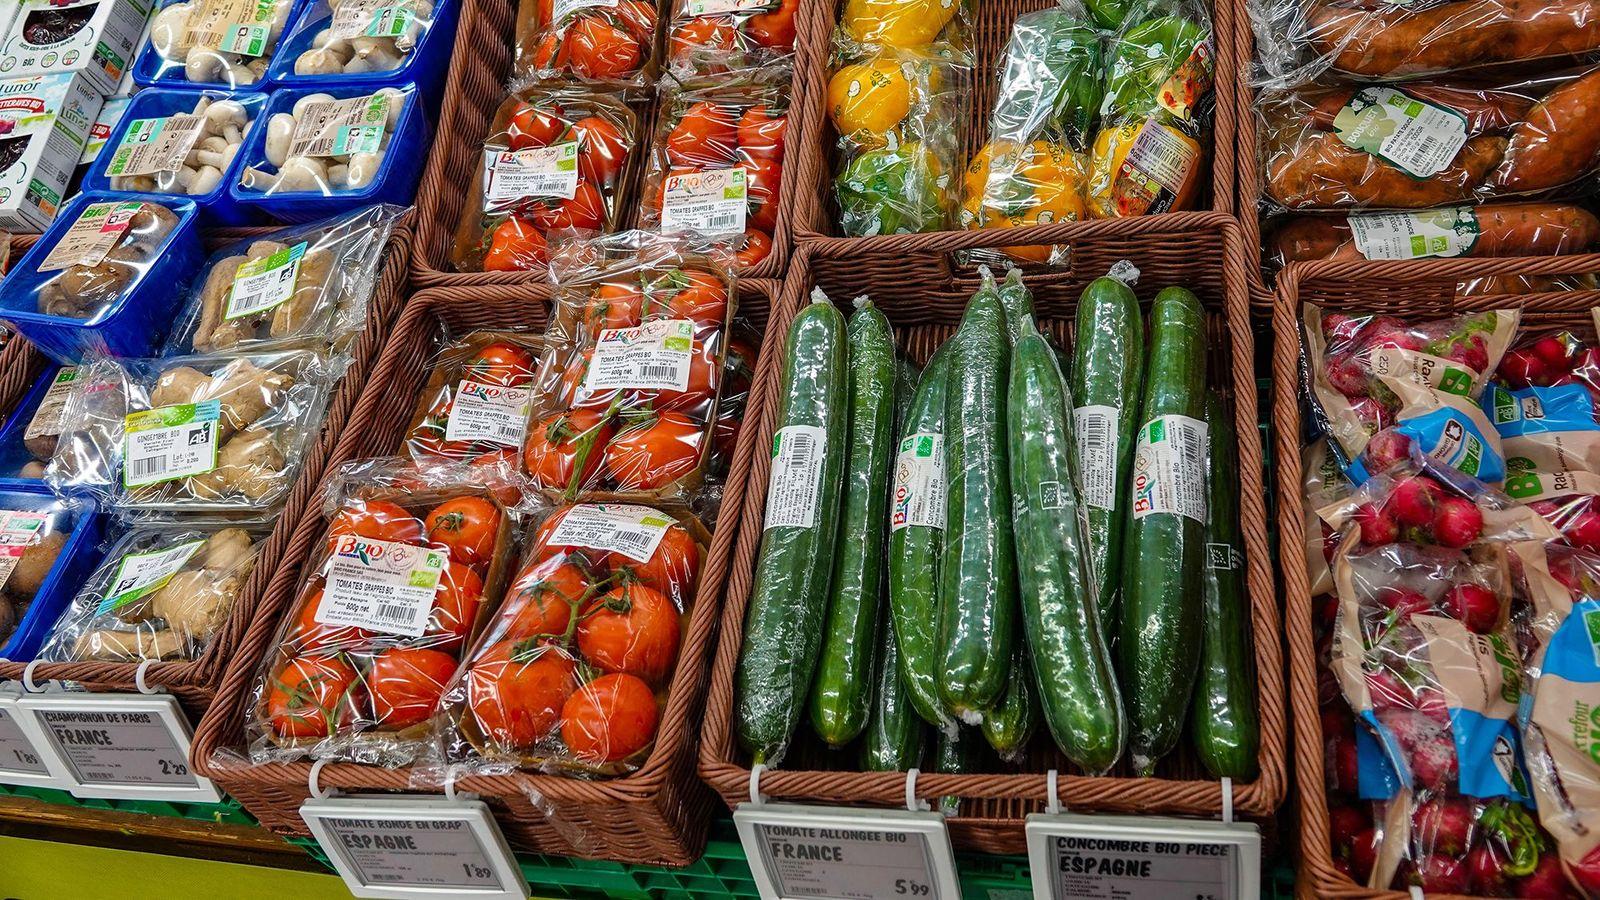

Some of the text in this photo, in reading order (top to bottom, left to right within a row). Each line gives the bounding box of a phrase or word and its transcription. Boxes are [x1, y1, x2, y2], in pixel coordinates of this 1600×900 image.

[22, 58, 35, 67] BIO
[76, 83, 95, 101] Lunor
[60, 107, 89, 130] Lunor
[1347, 108, 1378, 145] BOUQUET
[1384, 116, 1414, 153] BIO PATATE DOUCE
[1405, 218, 1415, 236] DOUCE
[462, 382, 500, 399] BRIO
[190, 431, 206, 445] AB
[1135, 475, 1149, 513] BRIO
[1173, 462, 1184, 513] Concombre Bio
[770, 488, 781, 525] Concombre
[894, 487, 908, 525] BRIO
[926, 490, 937, 526] Concombre
[339, 538, 383, 559] BRIO
[335, 578, 394, 595] TOMATES GRAPPES BIO
[45, 712, 151, 723] CHAMPIGNON DE PARIS
[56, 729, 113, 745] FRANCE
[332, 819, 462, 830] TOMATE RONDE EN GRAP
[764, 825, 906, 843] TOMATE ALLONGEE BIO
[342, 834, 418, 850] ESPAGNE
[1057, 836, 1231, 856] CONCOMBRE BIO PIECE
[771, 843, 843, 862] FRANCE
[1060, 856, 1152, 877] ESPAGNE
